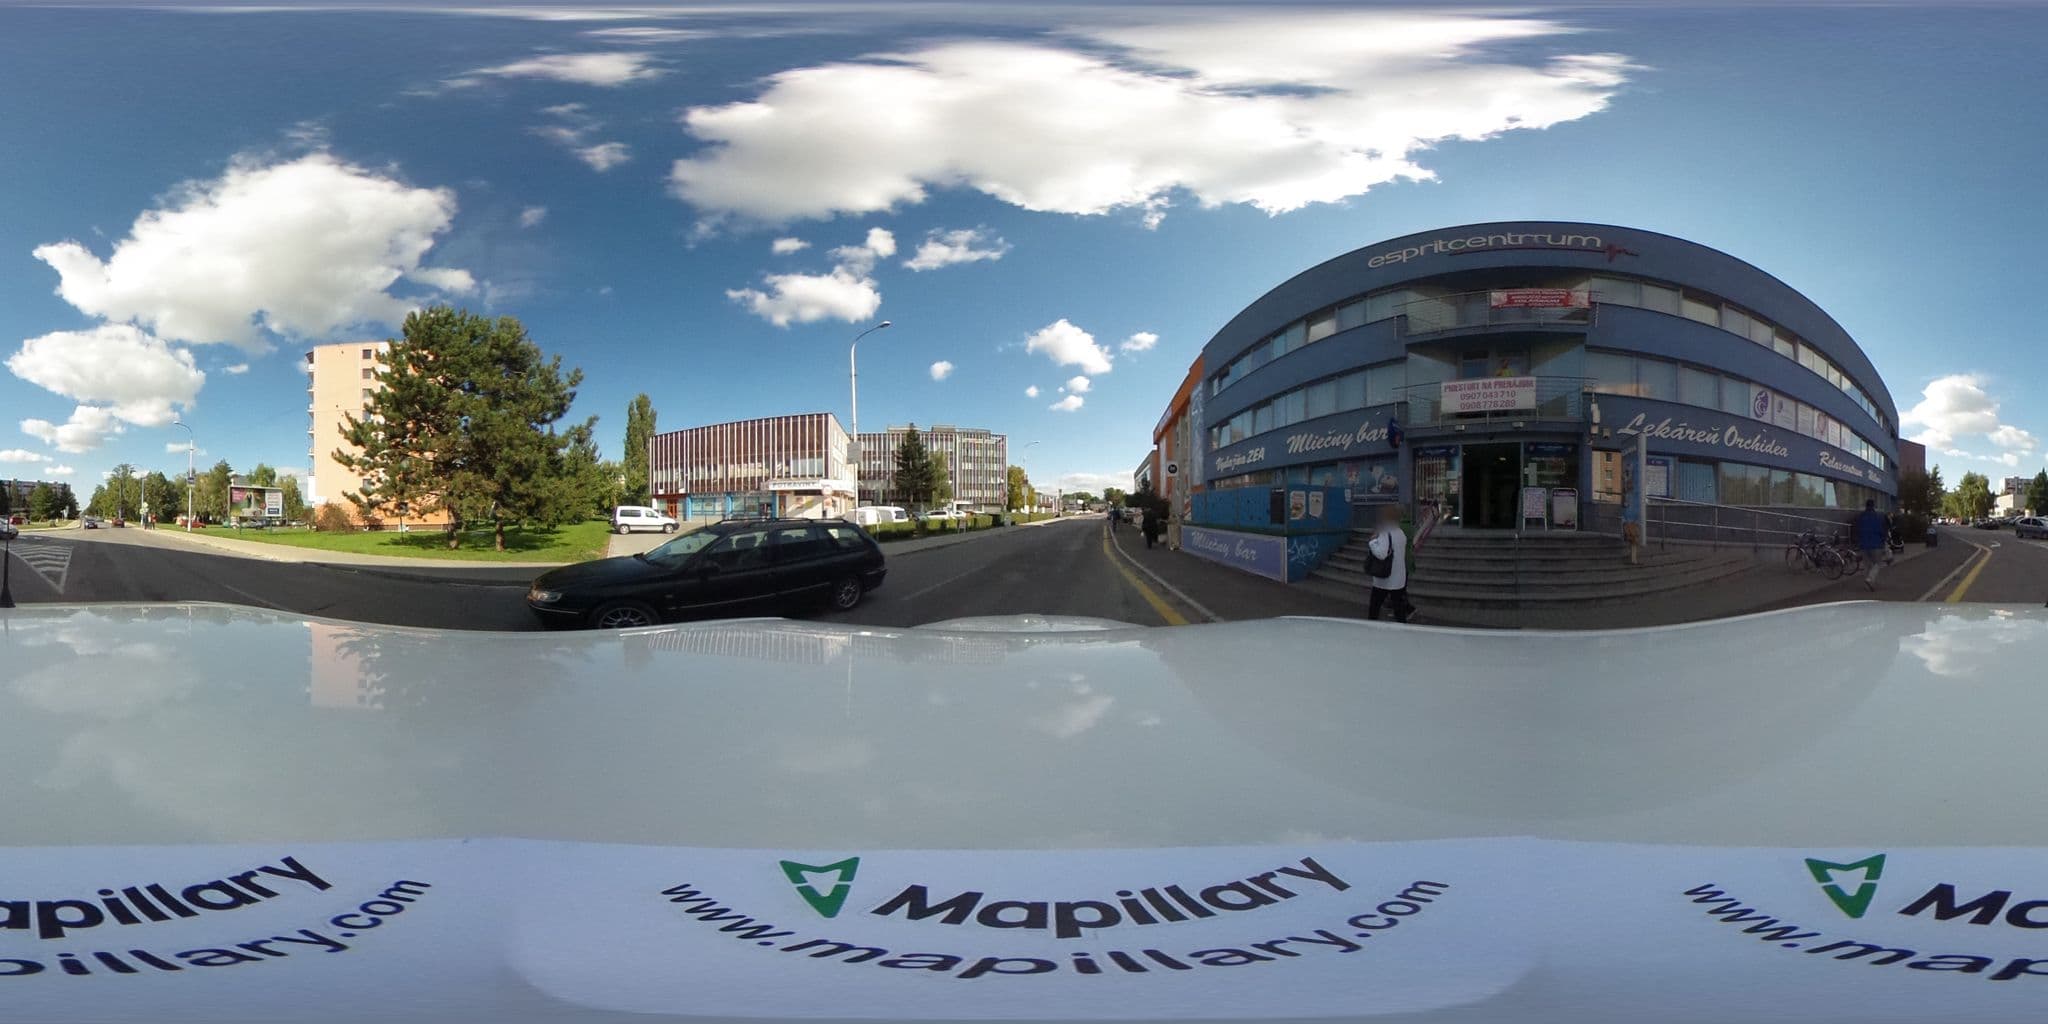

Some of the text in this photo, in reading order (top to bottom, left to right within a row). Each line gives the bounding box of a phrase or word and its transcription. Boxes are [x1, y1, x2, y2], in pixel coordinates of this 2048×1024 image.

[1356, 420, 1389, 444] bar
[1723, 424, 1790, 458] Orchidea
[870, 856, 1351, 940] Mapillary
[661, 880, 1450, 980] www.mapillary.com
